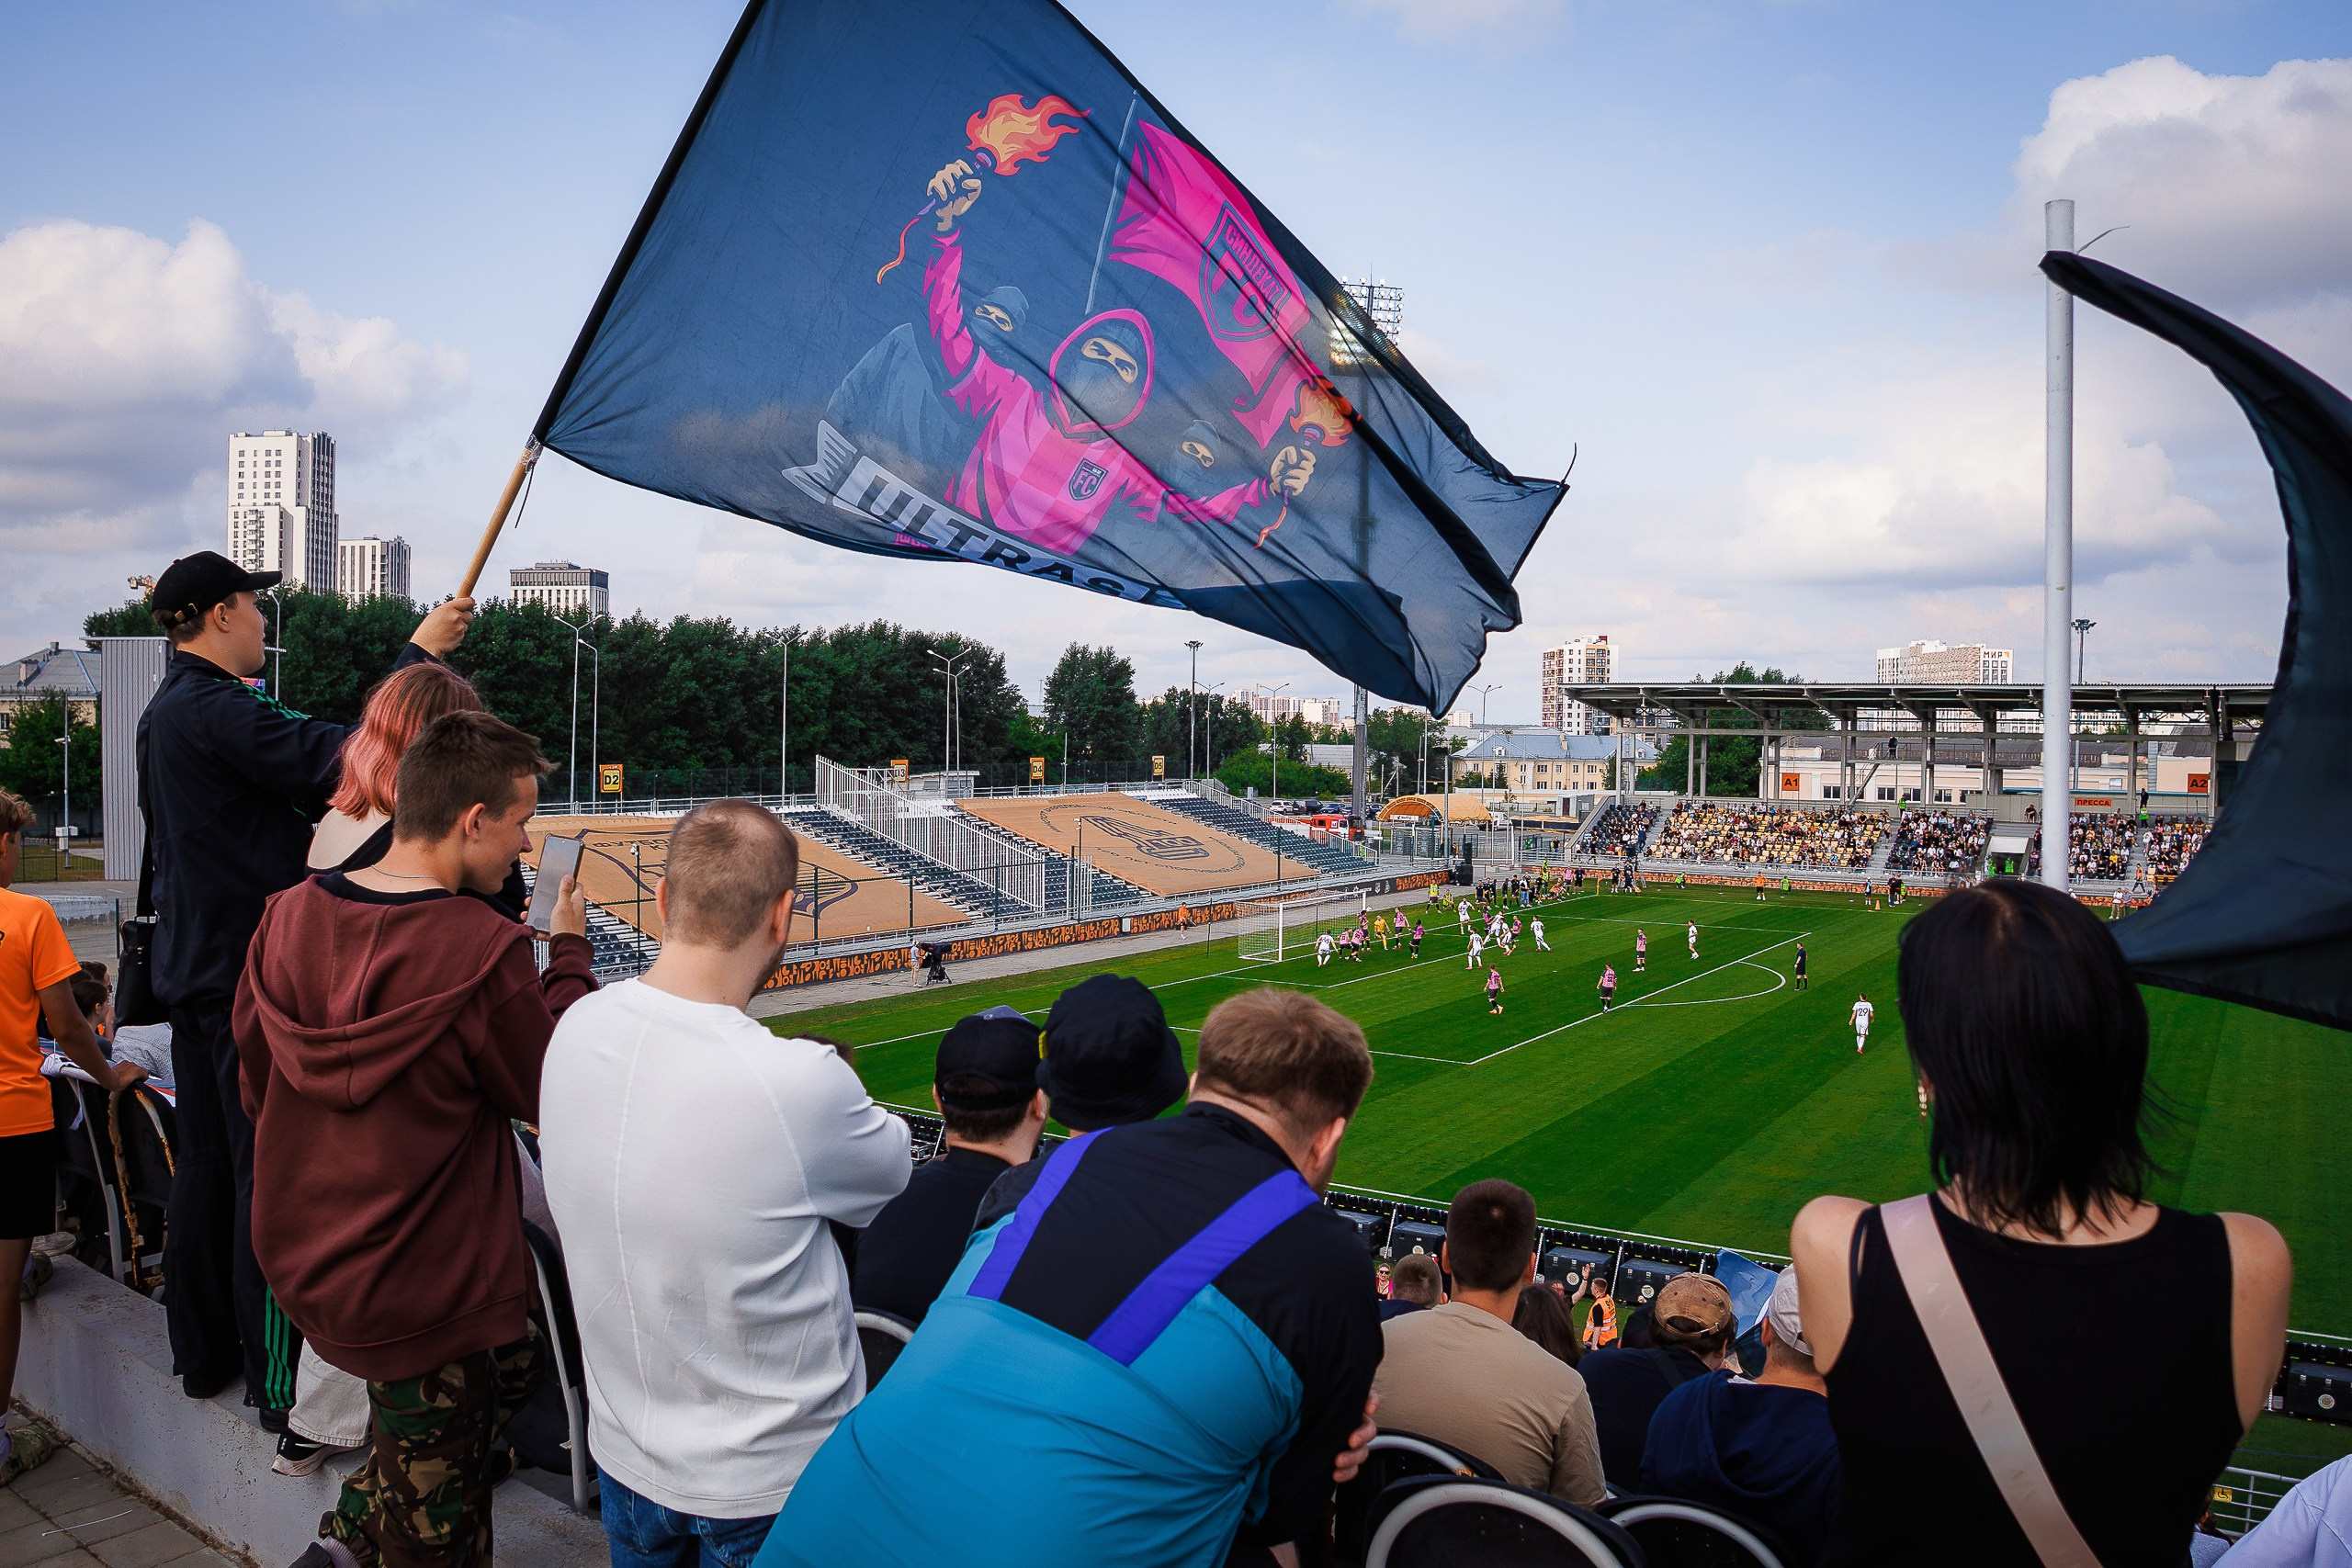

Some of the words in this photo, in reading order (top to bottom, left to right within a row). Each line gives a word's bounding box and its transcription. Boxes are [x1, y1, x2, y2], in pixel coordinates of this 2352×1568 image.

[1072, 469, 1098, 496] FC
[857, 475, 1127, 597] ULTRAS
[1033, 765, 1043, 773] D4
[1154, 761, 1163, 770] D5
[604, 774, 620, 785] D2
[1784, 778, 1798, 786] A1
[2189, 778, 2208, 788] A2
[2076, 798, 2110, 807] ПРЕССА
[1152, 838, 1194, 849] 100
[1858, 1007, 1869, 1017] 29
